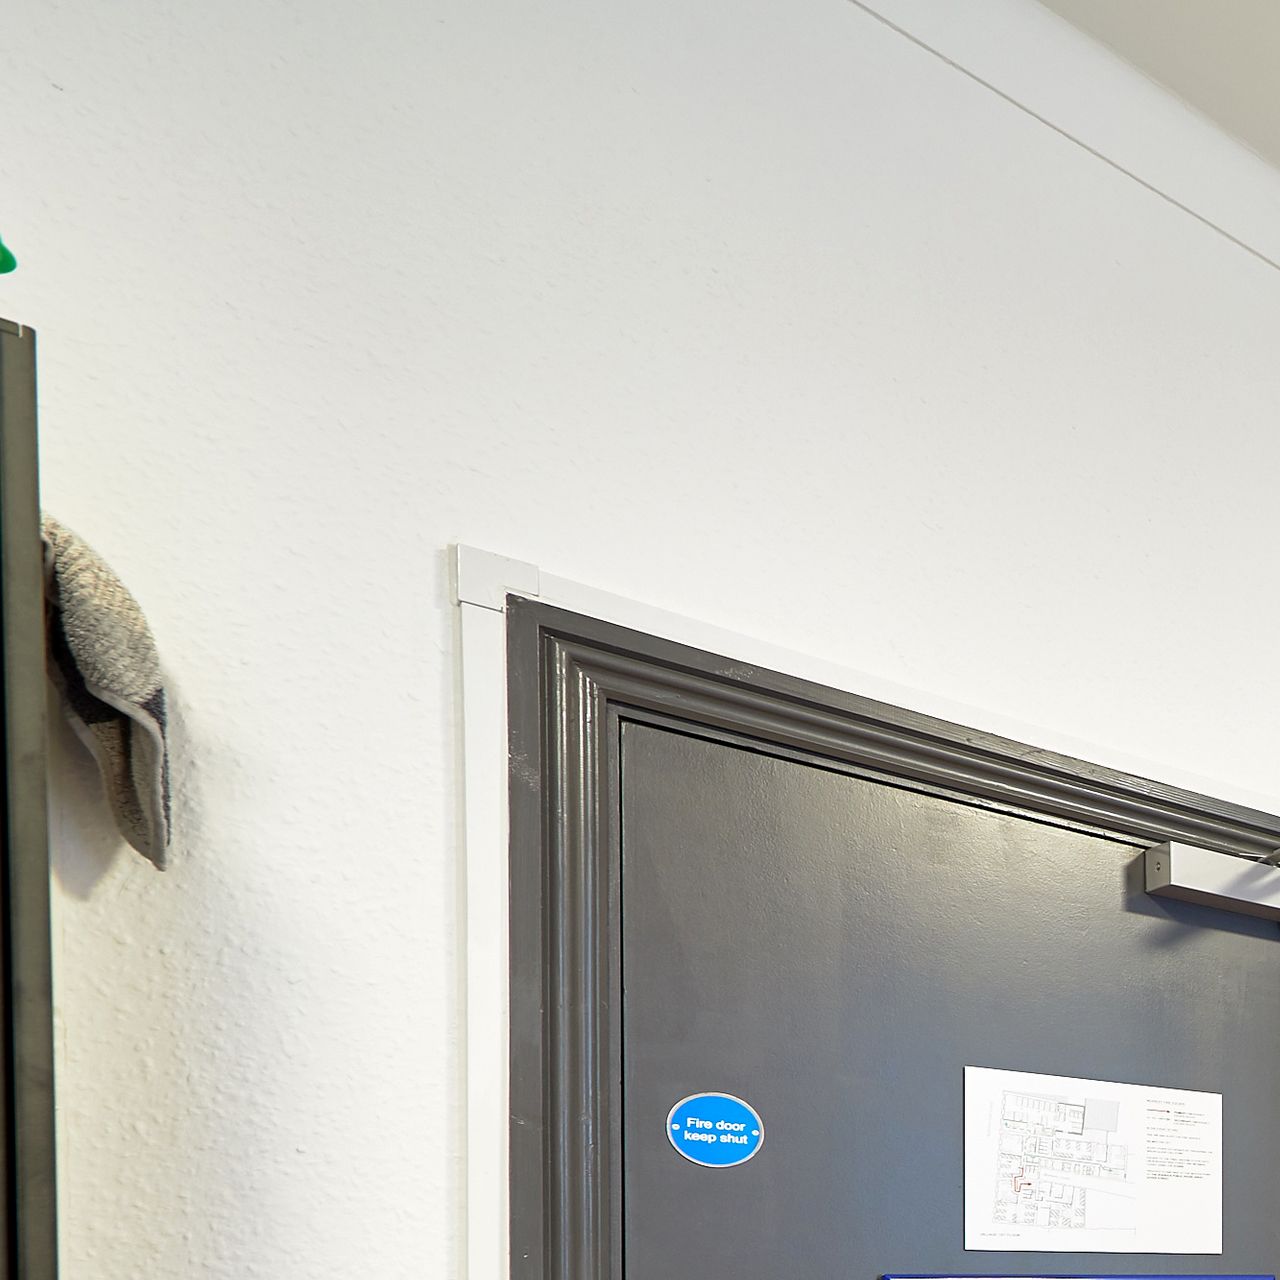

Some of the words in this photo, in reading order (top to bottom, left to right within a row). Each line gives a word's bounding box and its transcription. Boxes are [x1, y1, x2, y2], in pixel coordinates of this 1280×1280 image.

[687, 1117, 712, 1129] Fire
[716, 1120, 746, 1131] door
[684, 1130, 716, 1144] keep
[720, 1133, 748, 1144] shut
